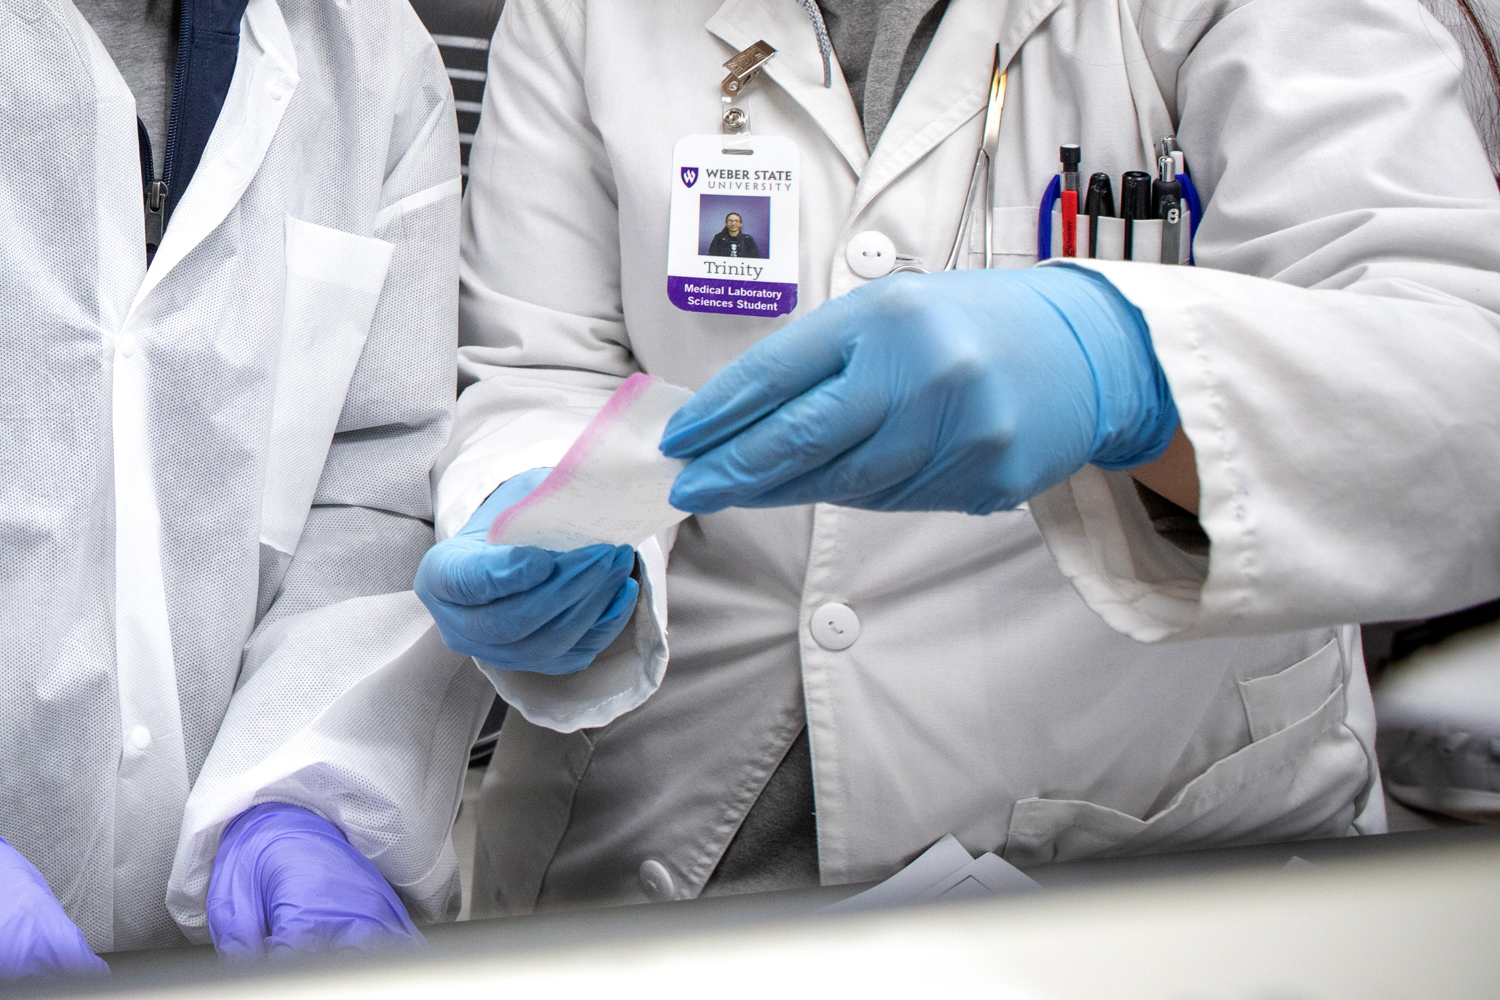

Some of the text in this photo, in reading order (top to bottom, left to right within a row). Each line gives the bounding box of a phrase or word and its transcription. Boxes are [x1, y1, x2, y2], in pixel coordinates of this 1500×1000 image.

[706, 168, 792, 181] WEBER STATE
[708, 181, 792, 191] UNIVERSITY
[703, 261, 764, 280] Trinity
[684, 283, 782, 301] Medical Laboratory
[687, 296, 778, 311] Sciences Student
